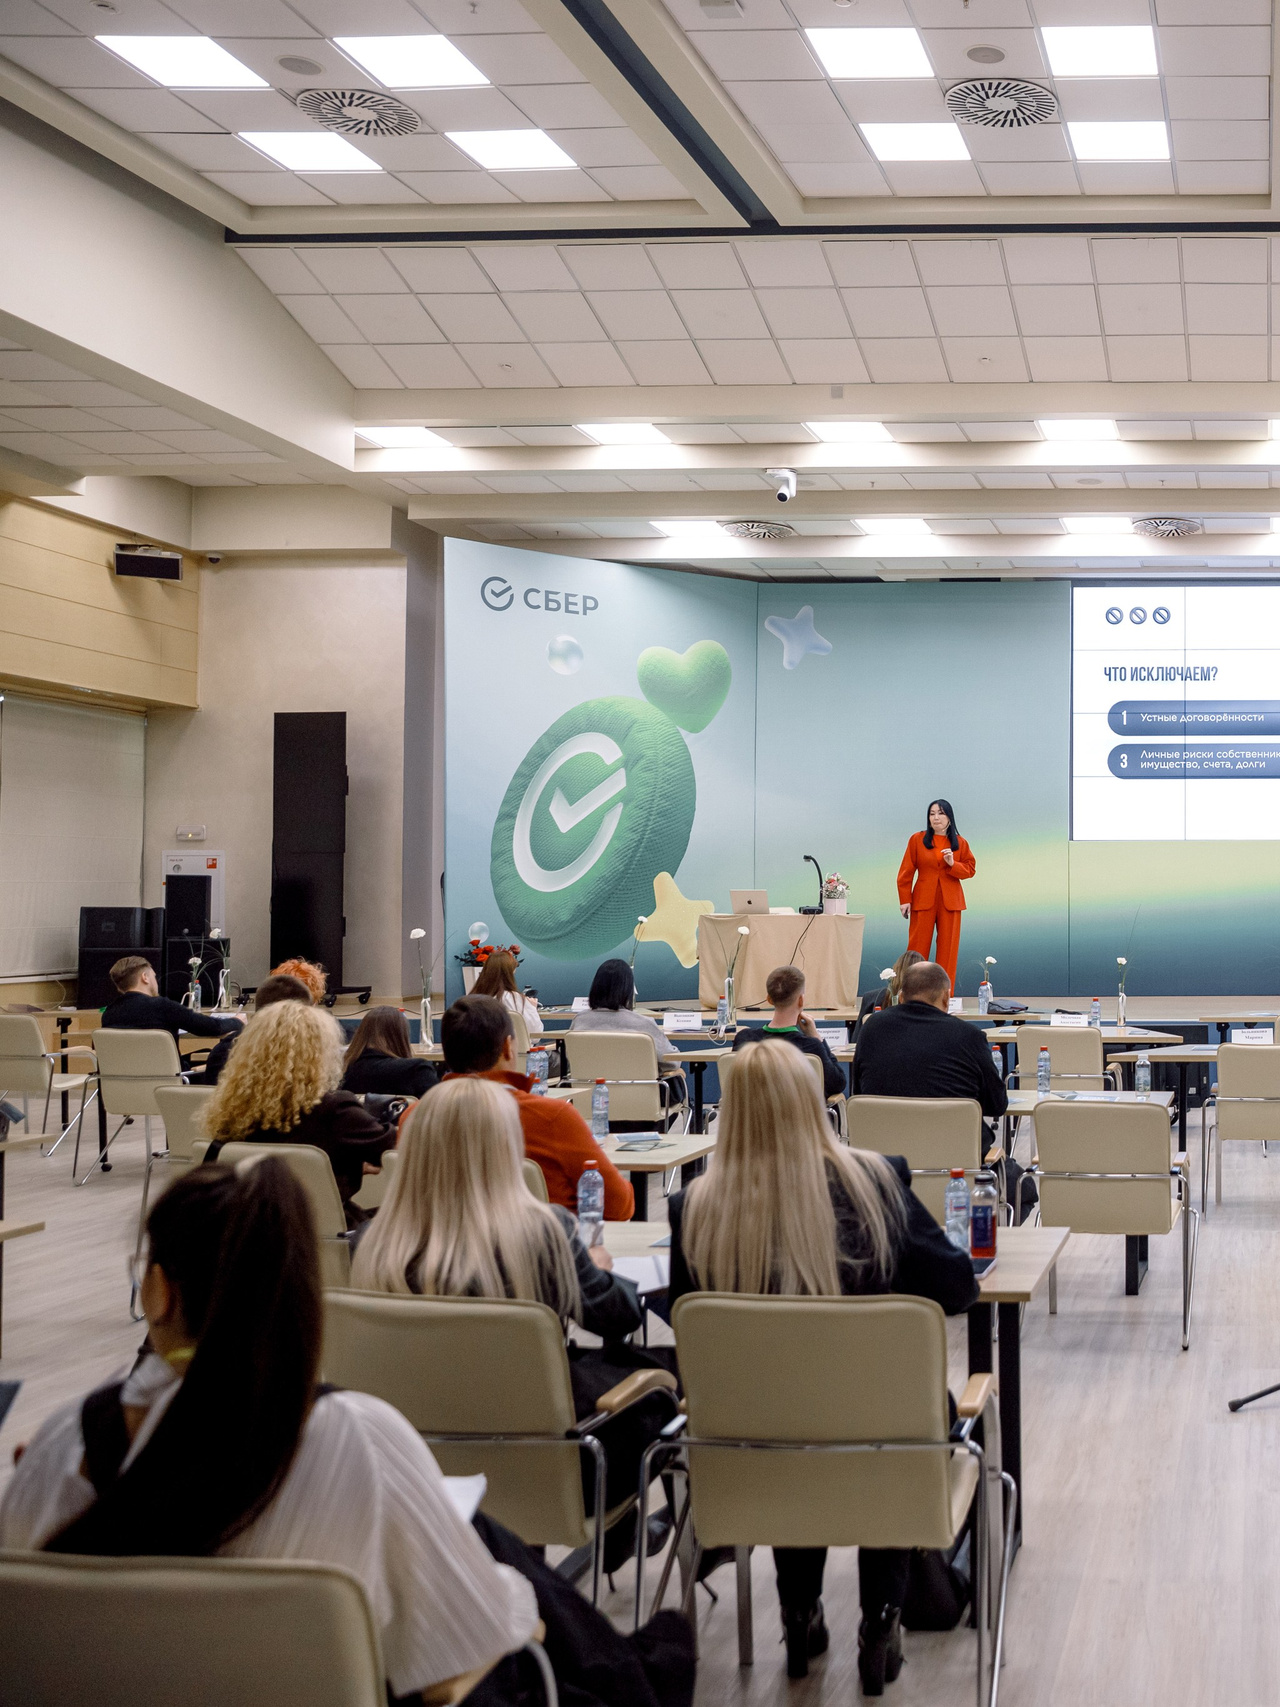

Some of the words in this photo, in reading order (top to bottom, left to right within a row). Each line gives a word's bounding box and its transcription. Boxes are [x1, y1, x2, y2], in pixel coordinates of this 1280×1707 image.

[523, 587, 599, 616] СБЕР
[1104, 666, 1127, 682] ЧТО
[1130, 666, 1219, 682] ИСКЛЮЧАЕМ?
[1121, 710, 1127, 725] 1
[1140, 713, 1178, 722] Устные
[1179, 712, 1265, 723] договорённости
[1120, 753, 1128, 768] 3
[1140, 750, 1180, 758] Личные
[1182, 750, 1213, 760] риски
[1140, 760, 1200, 770] имущество,
[1203, 760, 1234, 769] счета,
[1236, 760, 1266, 769] долги
